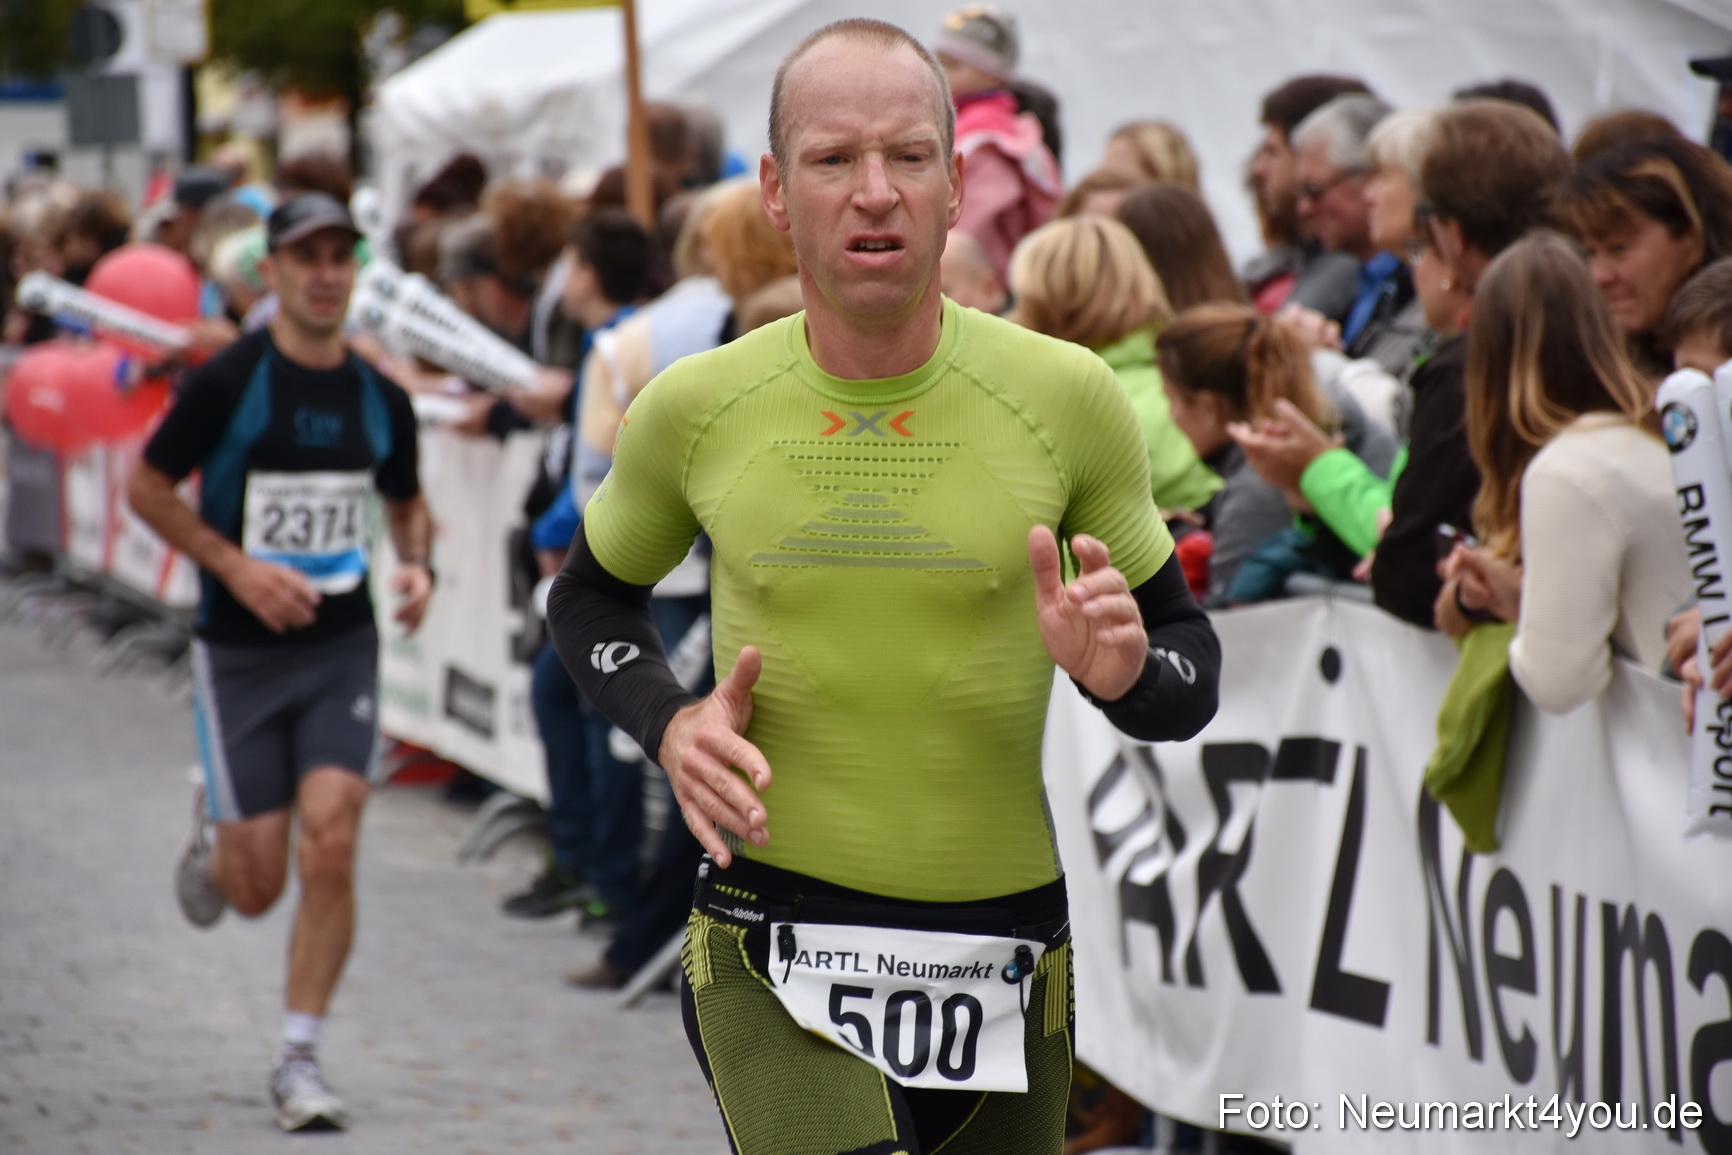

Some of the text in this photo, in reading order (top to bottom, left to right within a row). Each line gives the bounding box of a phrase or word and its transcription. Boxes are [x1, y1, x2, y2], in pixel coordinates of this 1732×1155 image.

[779, 949, 994, 981] ARTL Neumarkt
[828, 983, 983, 1082] 500
